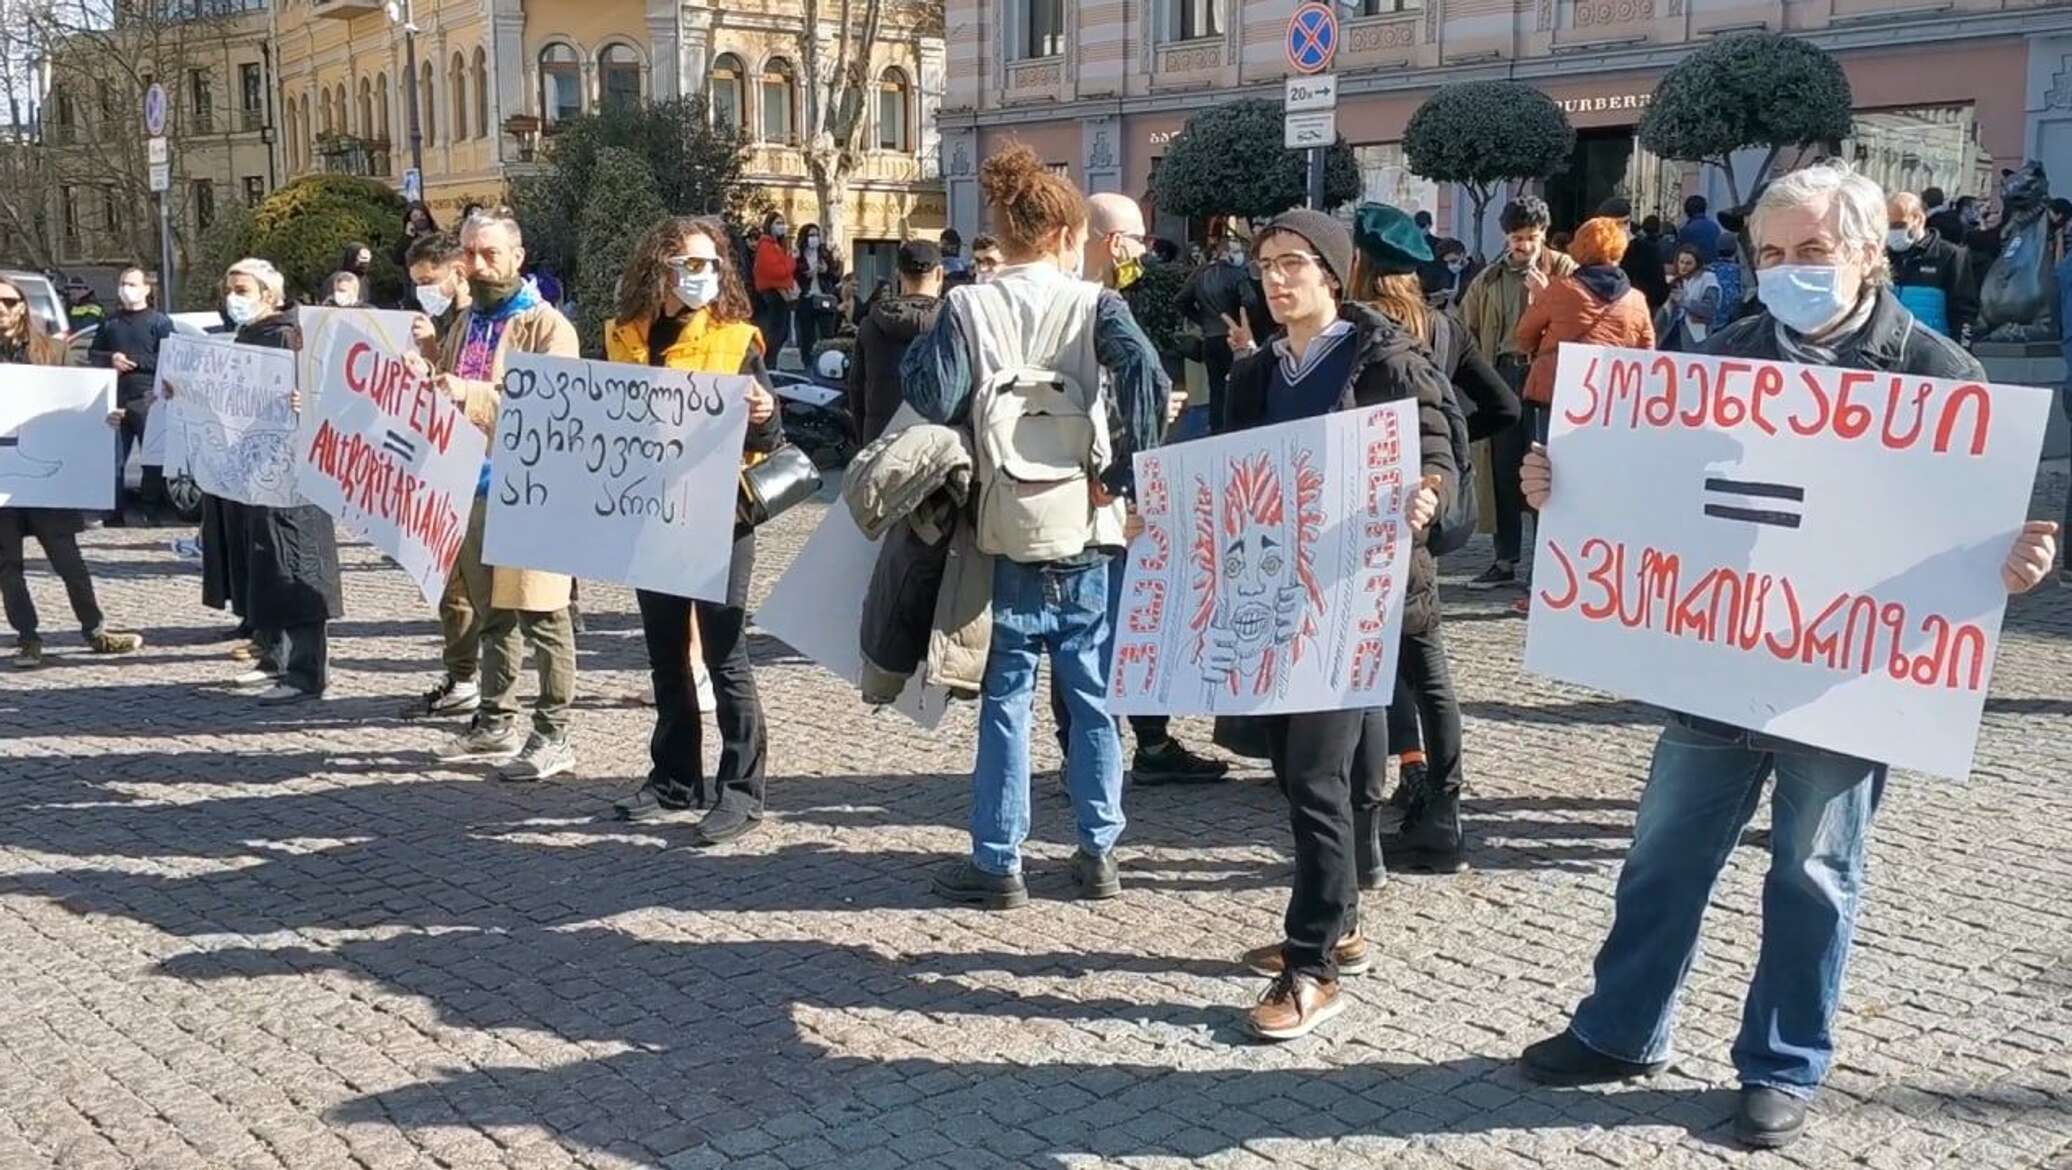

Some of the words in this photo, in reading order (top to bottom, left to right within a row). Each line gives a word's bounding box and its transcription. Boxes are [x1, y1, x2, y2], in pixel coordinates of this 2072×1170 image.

[346, 341, 455, 455] CURFEW
[503, 362, 725, 426] თავისუფლება
[1564, 356, 1991, 456] კომენდანტი
[500, 471, 548, 506] არ
[1540, 537, 1986, 691] ავტორიტარიზმი
